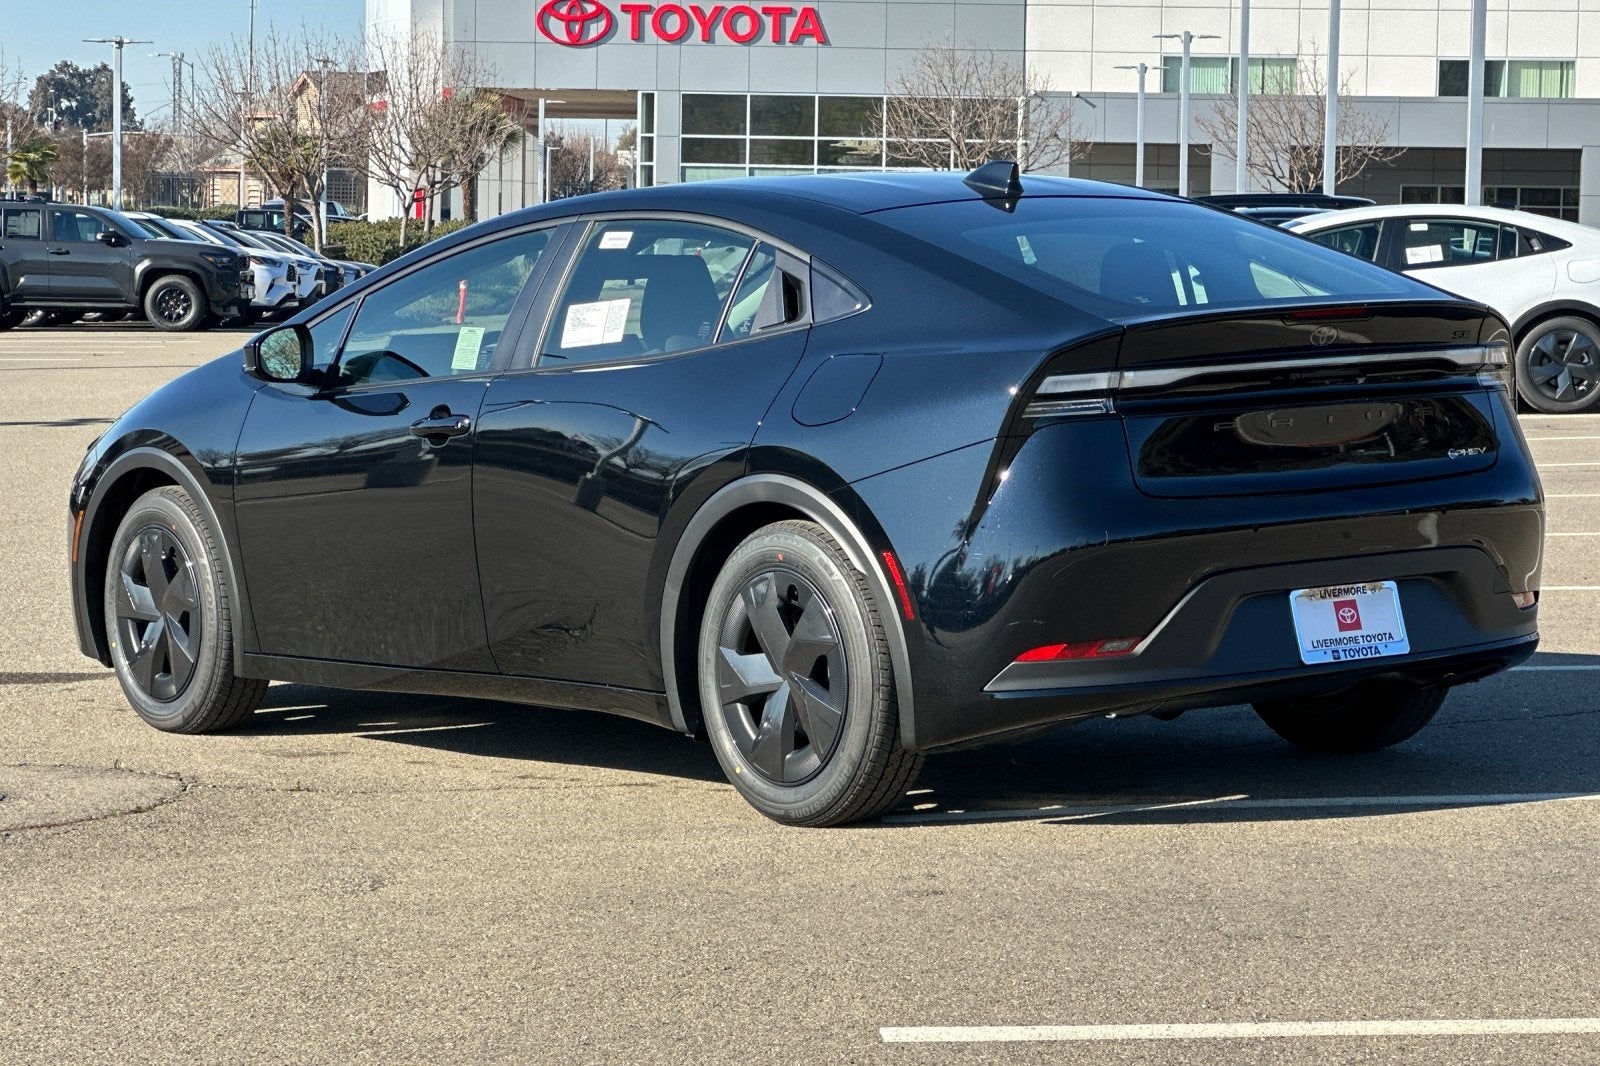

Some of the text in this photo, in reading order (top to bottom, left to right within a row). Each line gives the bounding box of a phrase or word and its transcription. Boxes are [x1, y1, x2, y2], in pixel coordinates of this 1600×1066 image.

[620, 4, 827, 44] TOYOTA
[1455, 446, 1487, 457] PHEV
[1319, 586, 1367, 599] LIVERMORE
[1311, 632, 1394, 649] LIVERMORE TOYOTA
[1342, 645, 1381, 659] TOYOTA
[788, 762, 850, 818] BRIDGESTONE
